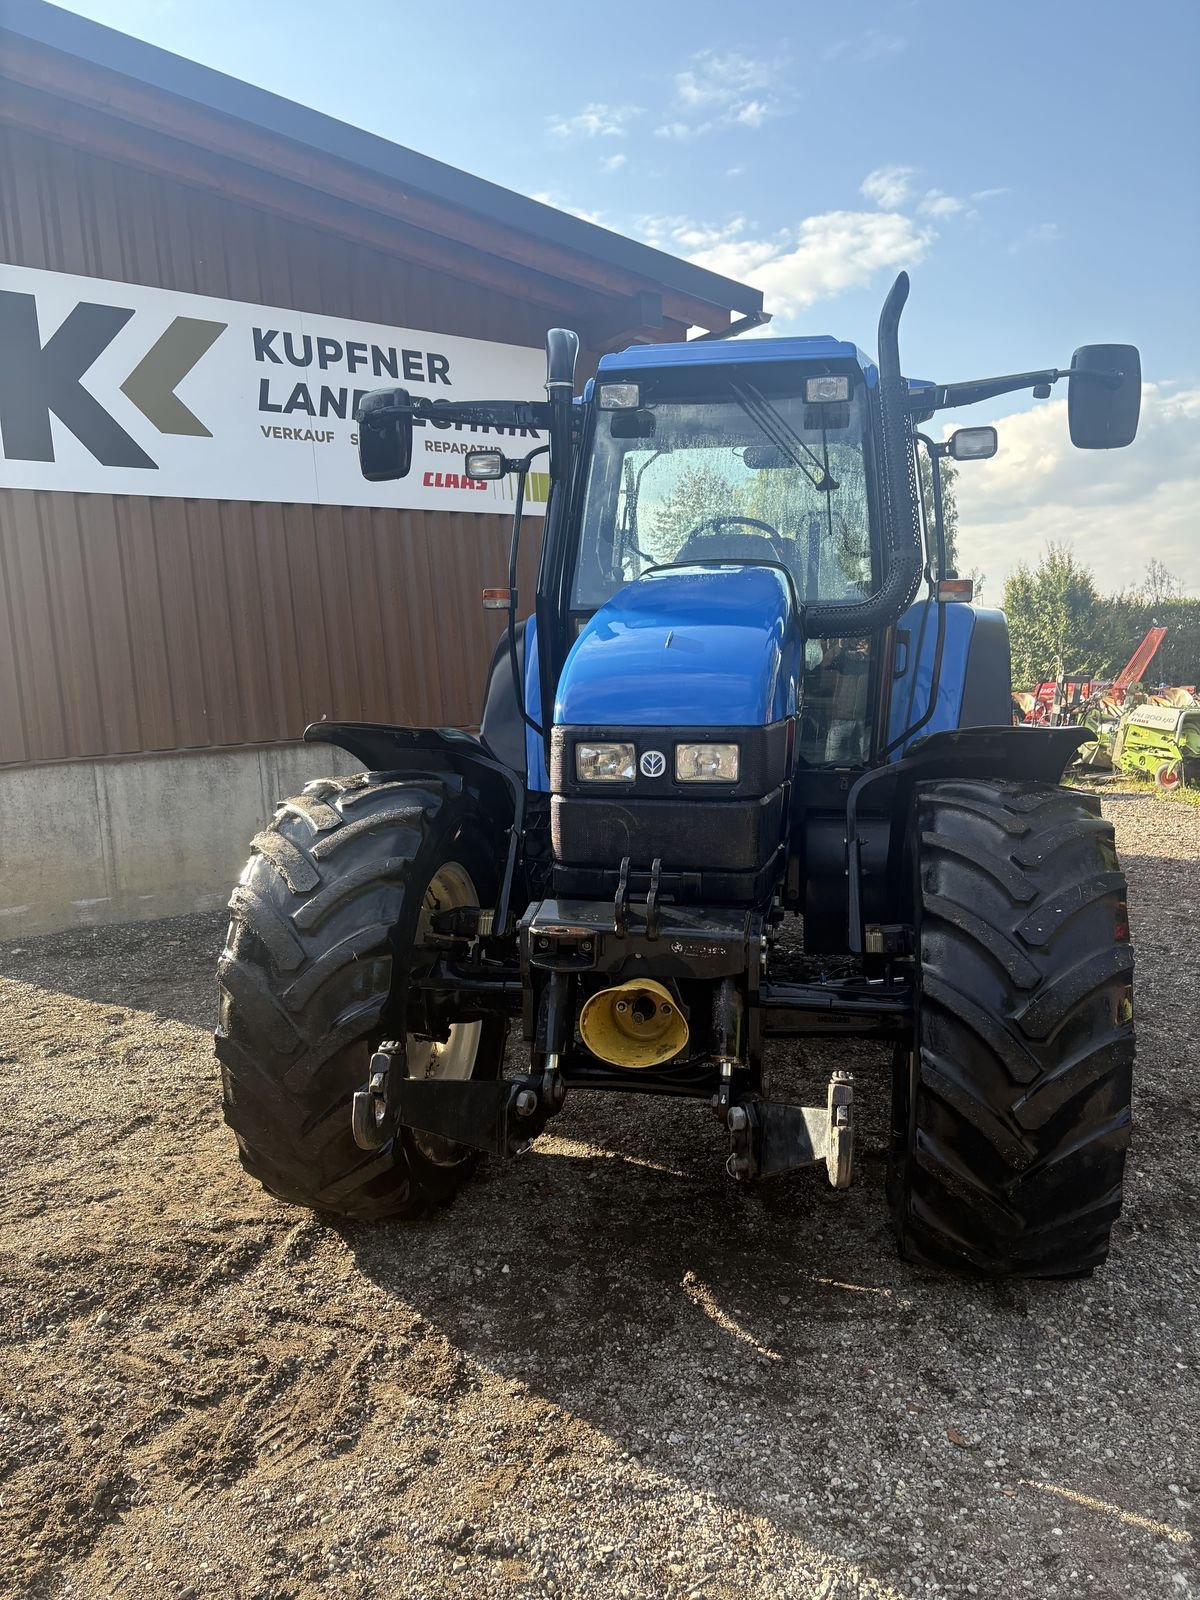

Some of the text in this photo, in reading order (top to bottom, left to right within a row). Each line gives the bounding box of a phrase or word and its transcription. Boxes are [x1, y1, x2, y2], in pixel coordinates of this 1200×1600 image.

[252, 327, 452, 385] KUPFNER
[260, 425, 335, 444] VERKAUF
[423, 472, 488, 490] CLAAS
